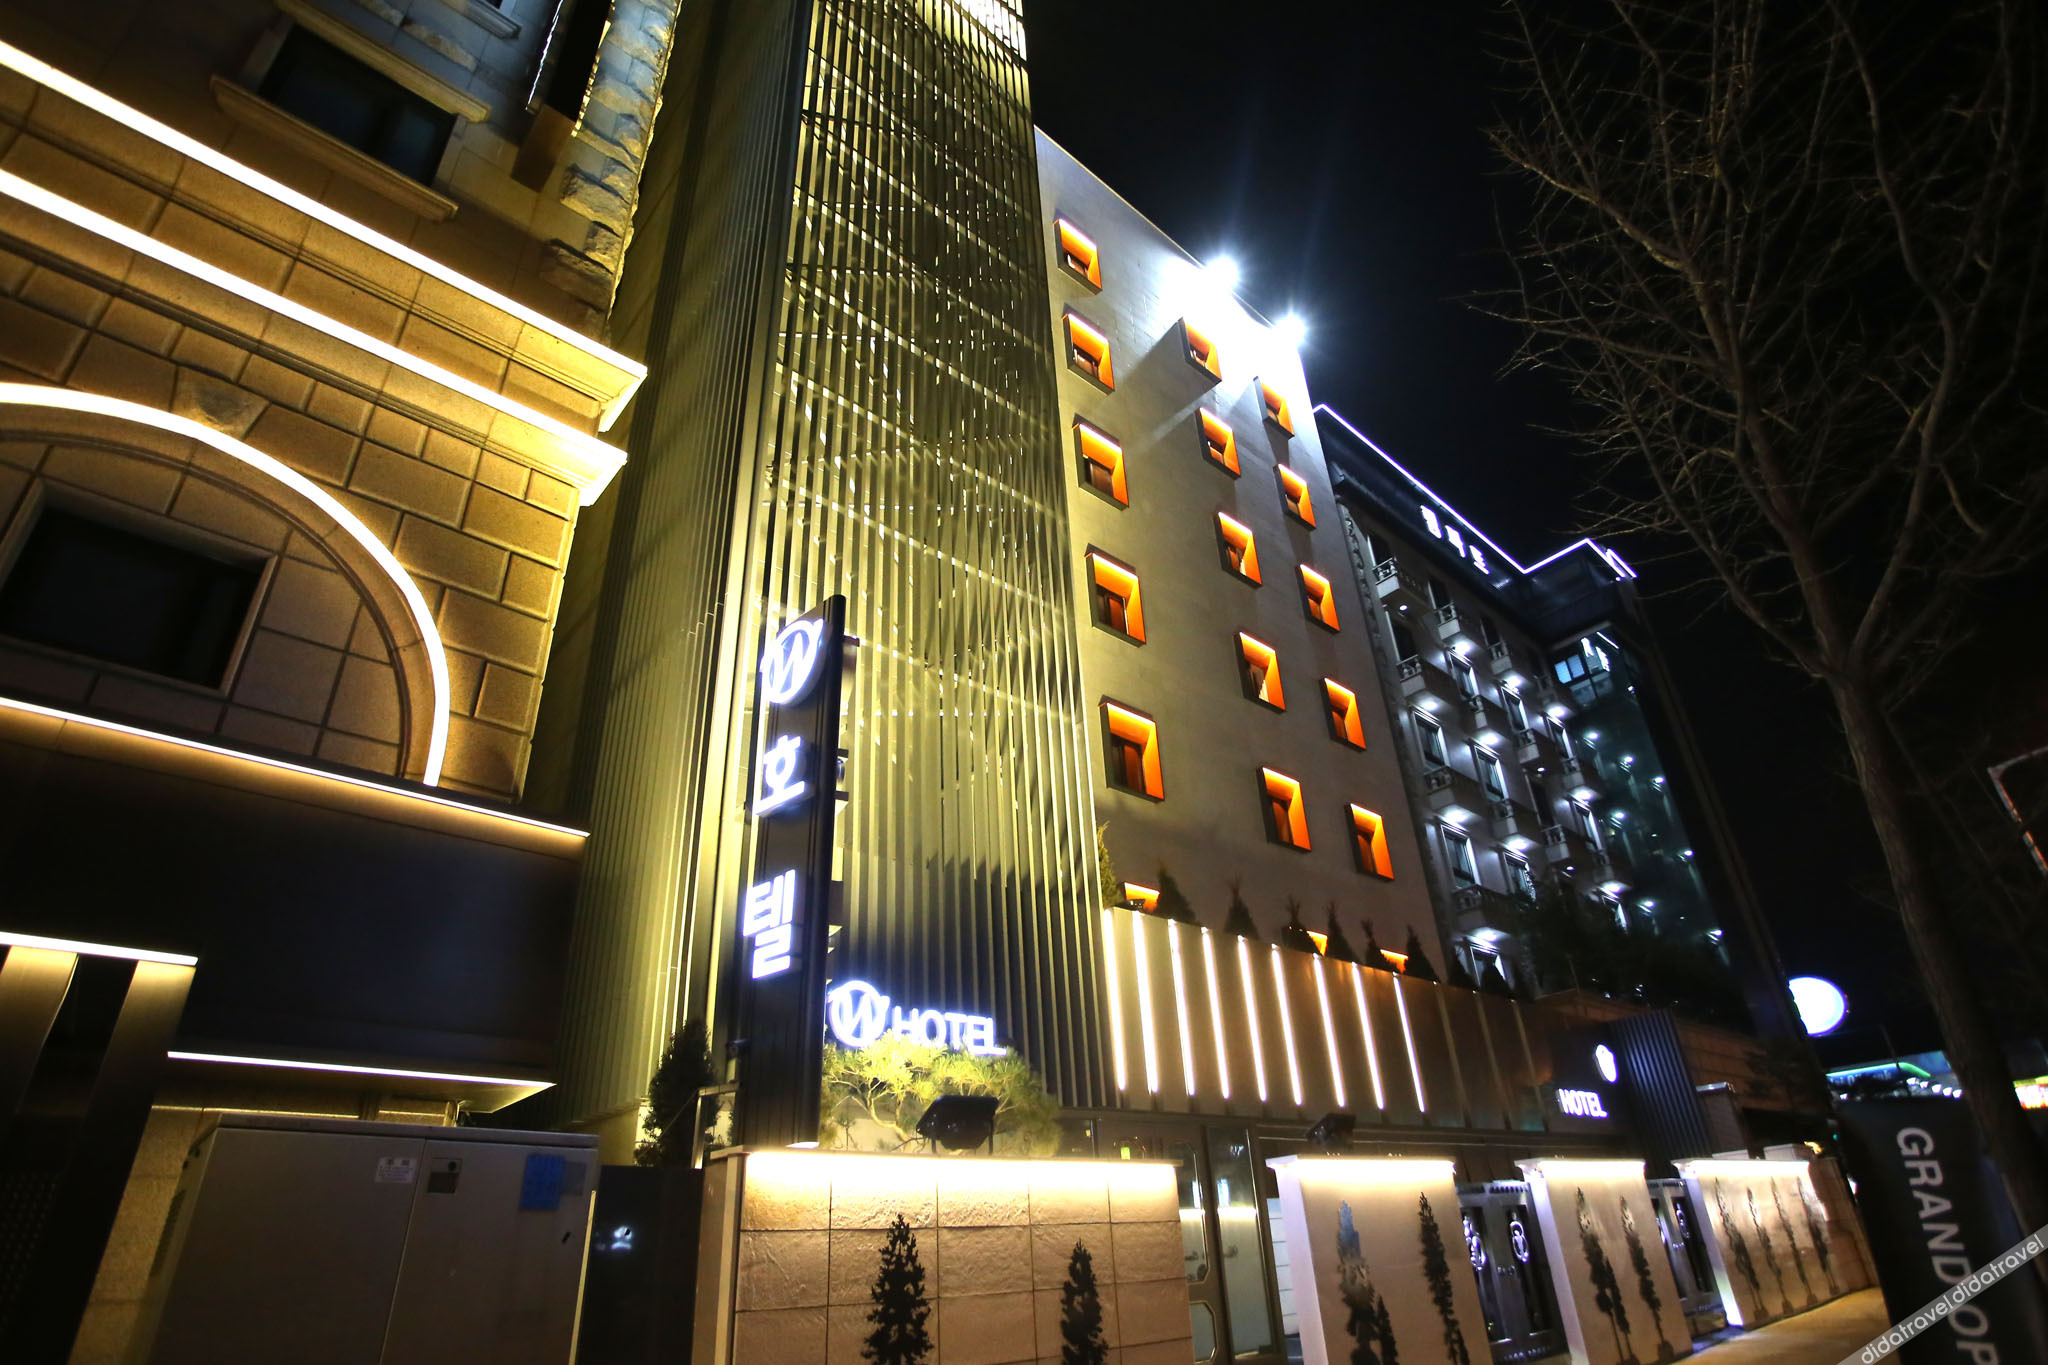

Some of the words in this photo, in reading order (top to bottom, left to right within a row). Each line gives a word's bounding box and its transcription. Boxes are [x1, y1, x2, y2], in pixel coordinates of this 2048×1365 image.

[743, 734, 806, 979] 호텔
[892, 1005, 1007, 1056] HOTEL
[1558, 1088, 1608, 1117] HOTEL
[1896, 1127, 1972, 1284] GRAND
